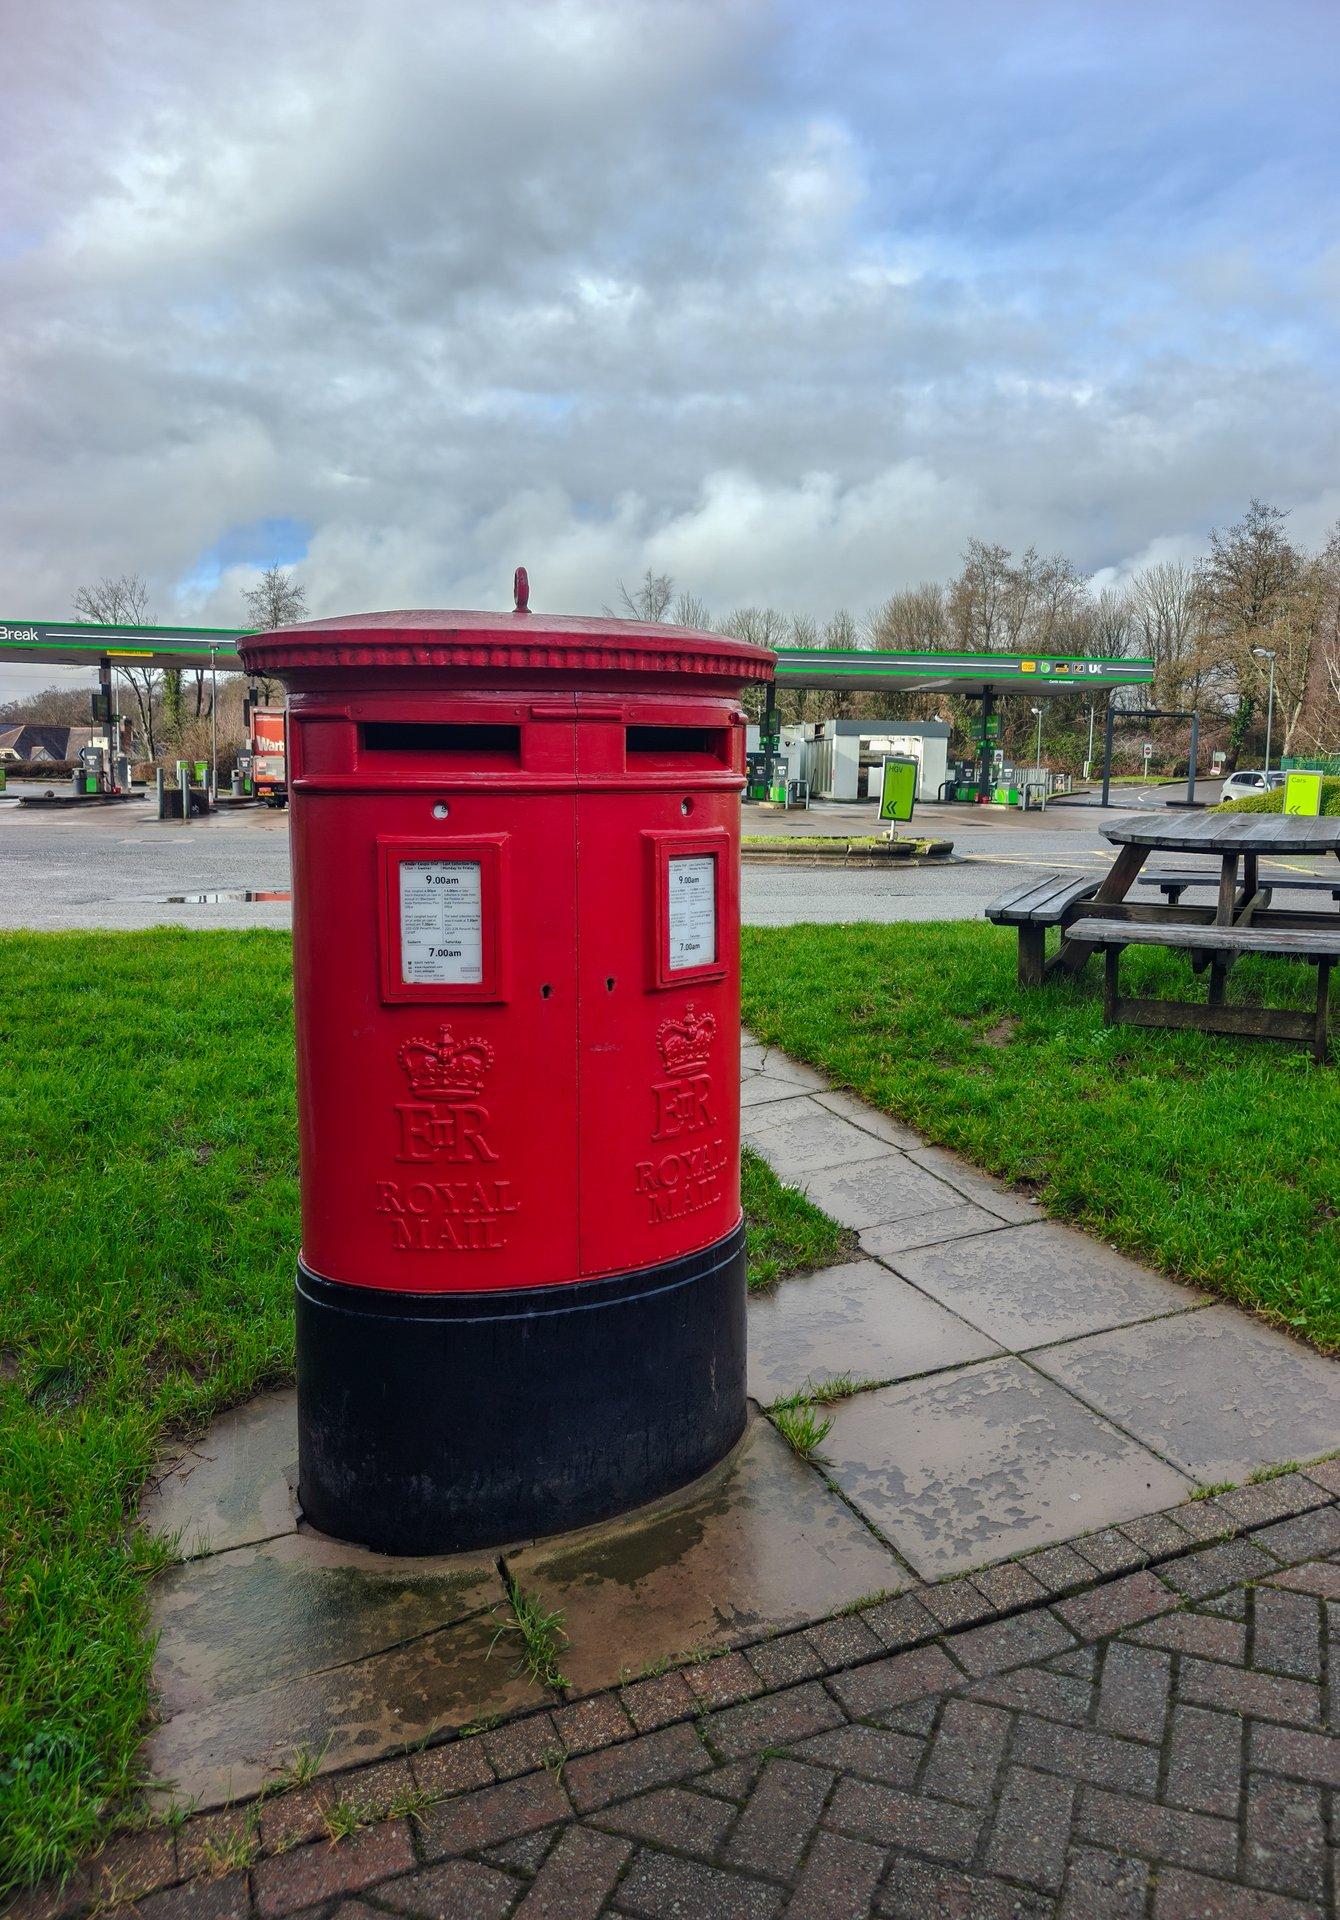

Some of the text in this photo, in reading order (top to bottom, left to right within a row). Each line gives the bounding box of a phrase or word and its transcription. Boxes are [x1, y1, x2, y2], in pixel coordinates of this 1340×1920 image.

[0, 626, 39, 641] Break
[888, 765, 904, 773] HGV
[426, 874, 459, 885] 9.00am
[679, 875, 700, 885] 9.00am
[428, 947, 462, 957] 7.00am
[680, 942, 701, 951] 7.00am
[634, 1138, 728, 1192] ROYAL
[376, 1180, 522, 1215] ROYAL
[647, 1173, 722, 1224] MAIL
[391, 1217, 509, 1250] MAIL
